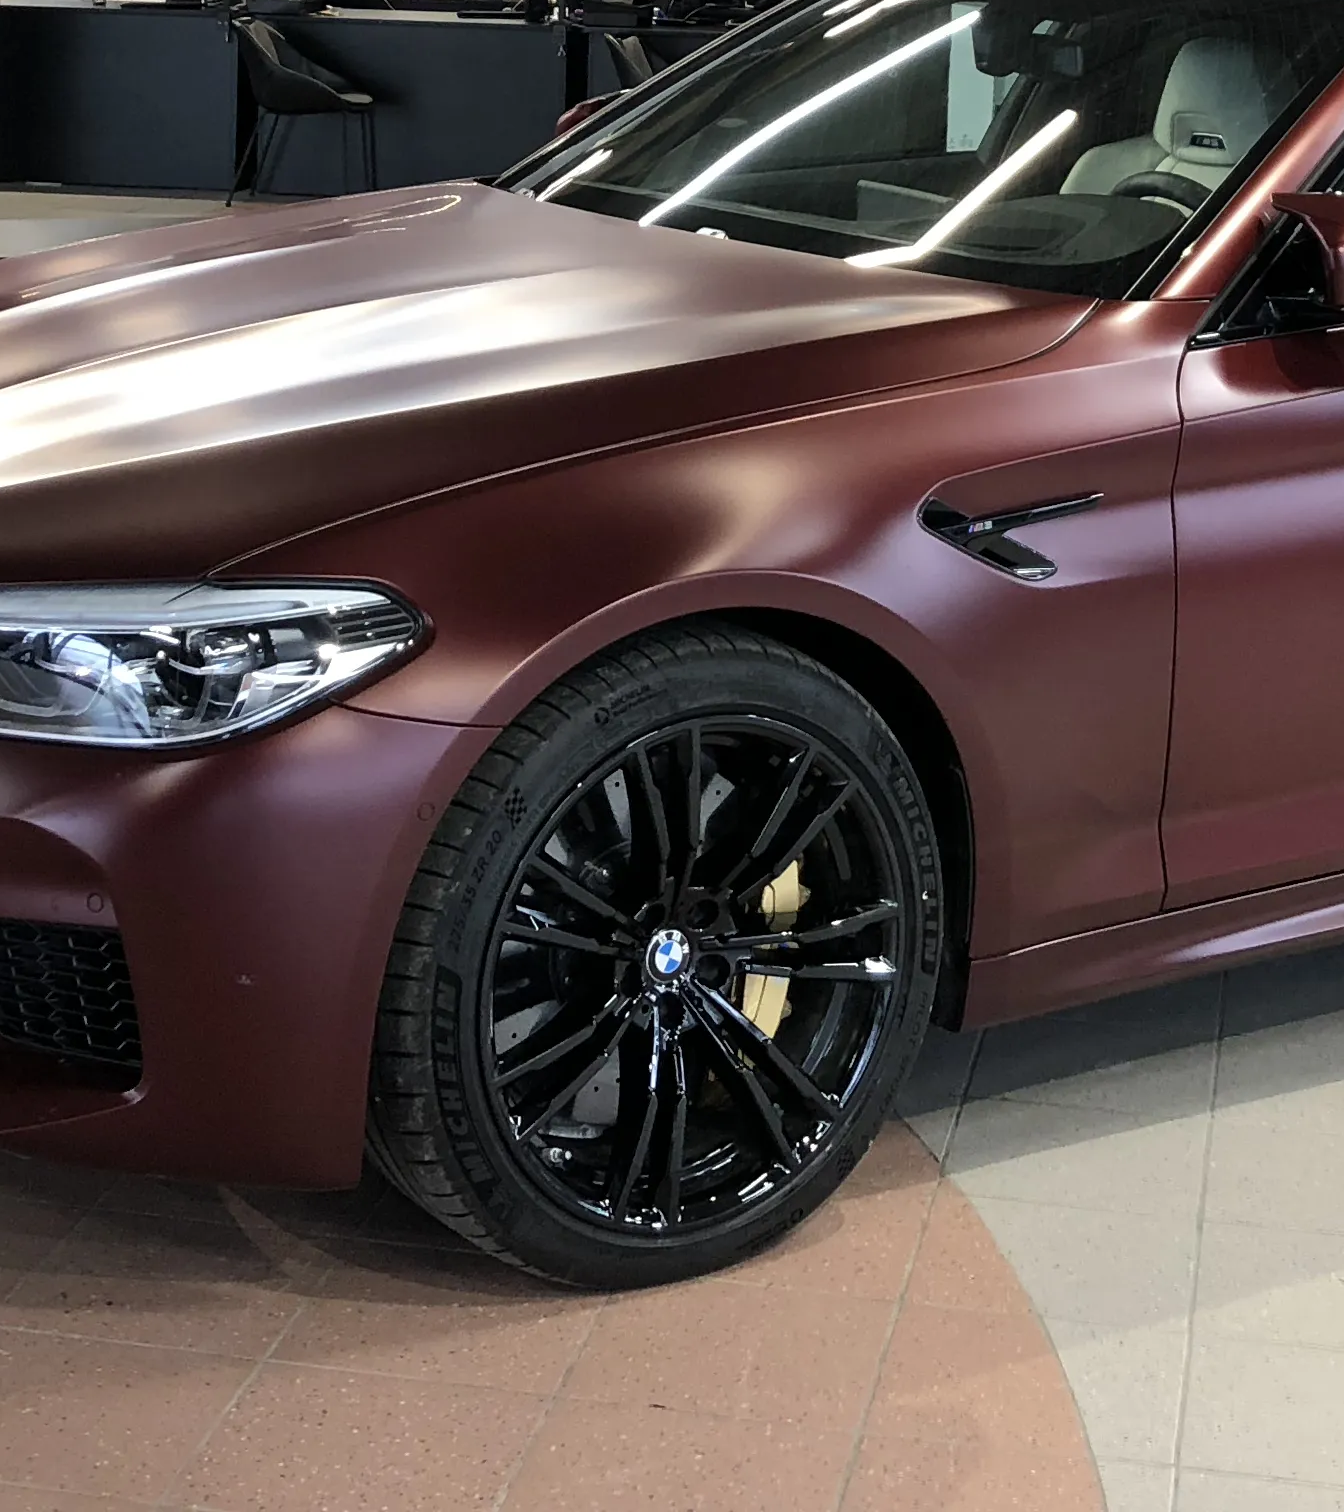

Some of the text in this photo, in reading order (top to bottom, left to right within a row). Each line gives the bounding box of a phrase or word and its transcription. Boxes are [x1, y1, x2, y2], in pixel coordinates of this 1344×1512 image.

[470, 856, 491, 885] ZR
[485, 829, 503, 856] 20
[892, 776, 938, 964] MICHELIN
[434, 979, 494, 1185] MICHELIN
